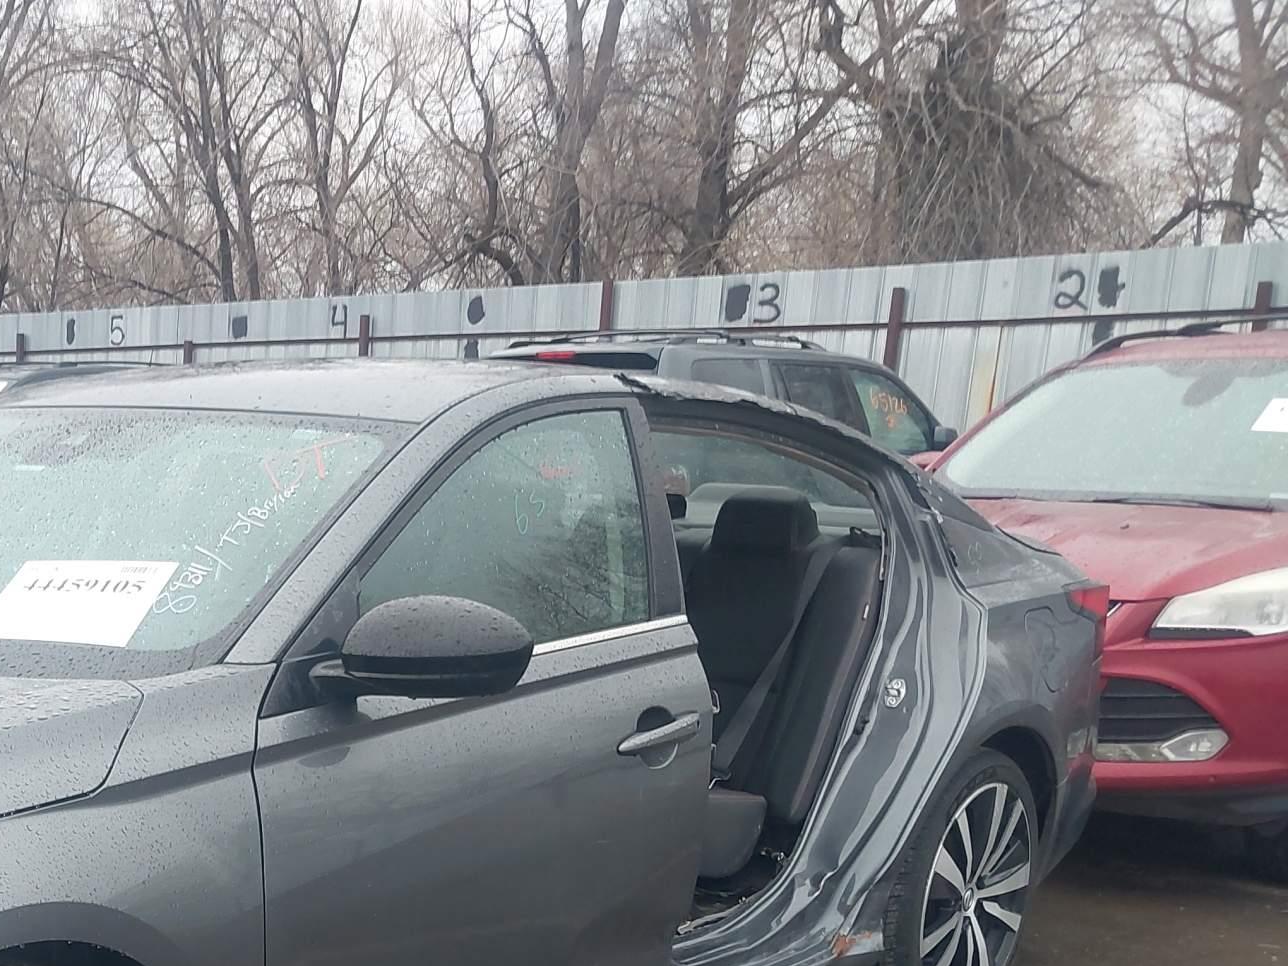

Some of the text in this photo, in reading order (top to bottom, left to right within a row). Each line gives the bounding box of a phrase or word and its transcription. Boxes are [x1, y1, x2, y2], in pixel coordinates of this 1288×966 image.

[753, 283, 781, 324] 3
[1054, 269, 1088, 311] 2
[110, 314, 126, 347] 5
[332, 303, 348, 340] 4
[24, 577, 146, 593] 44459105
